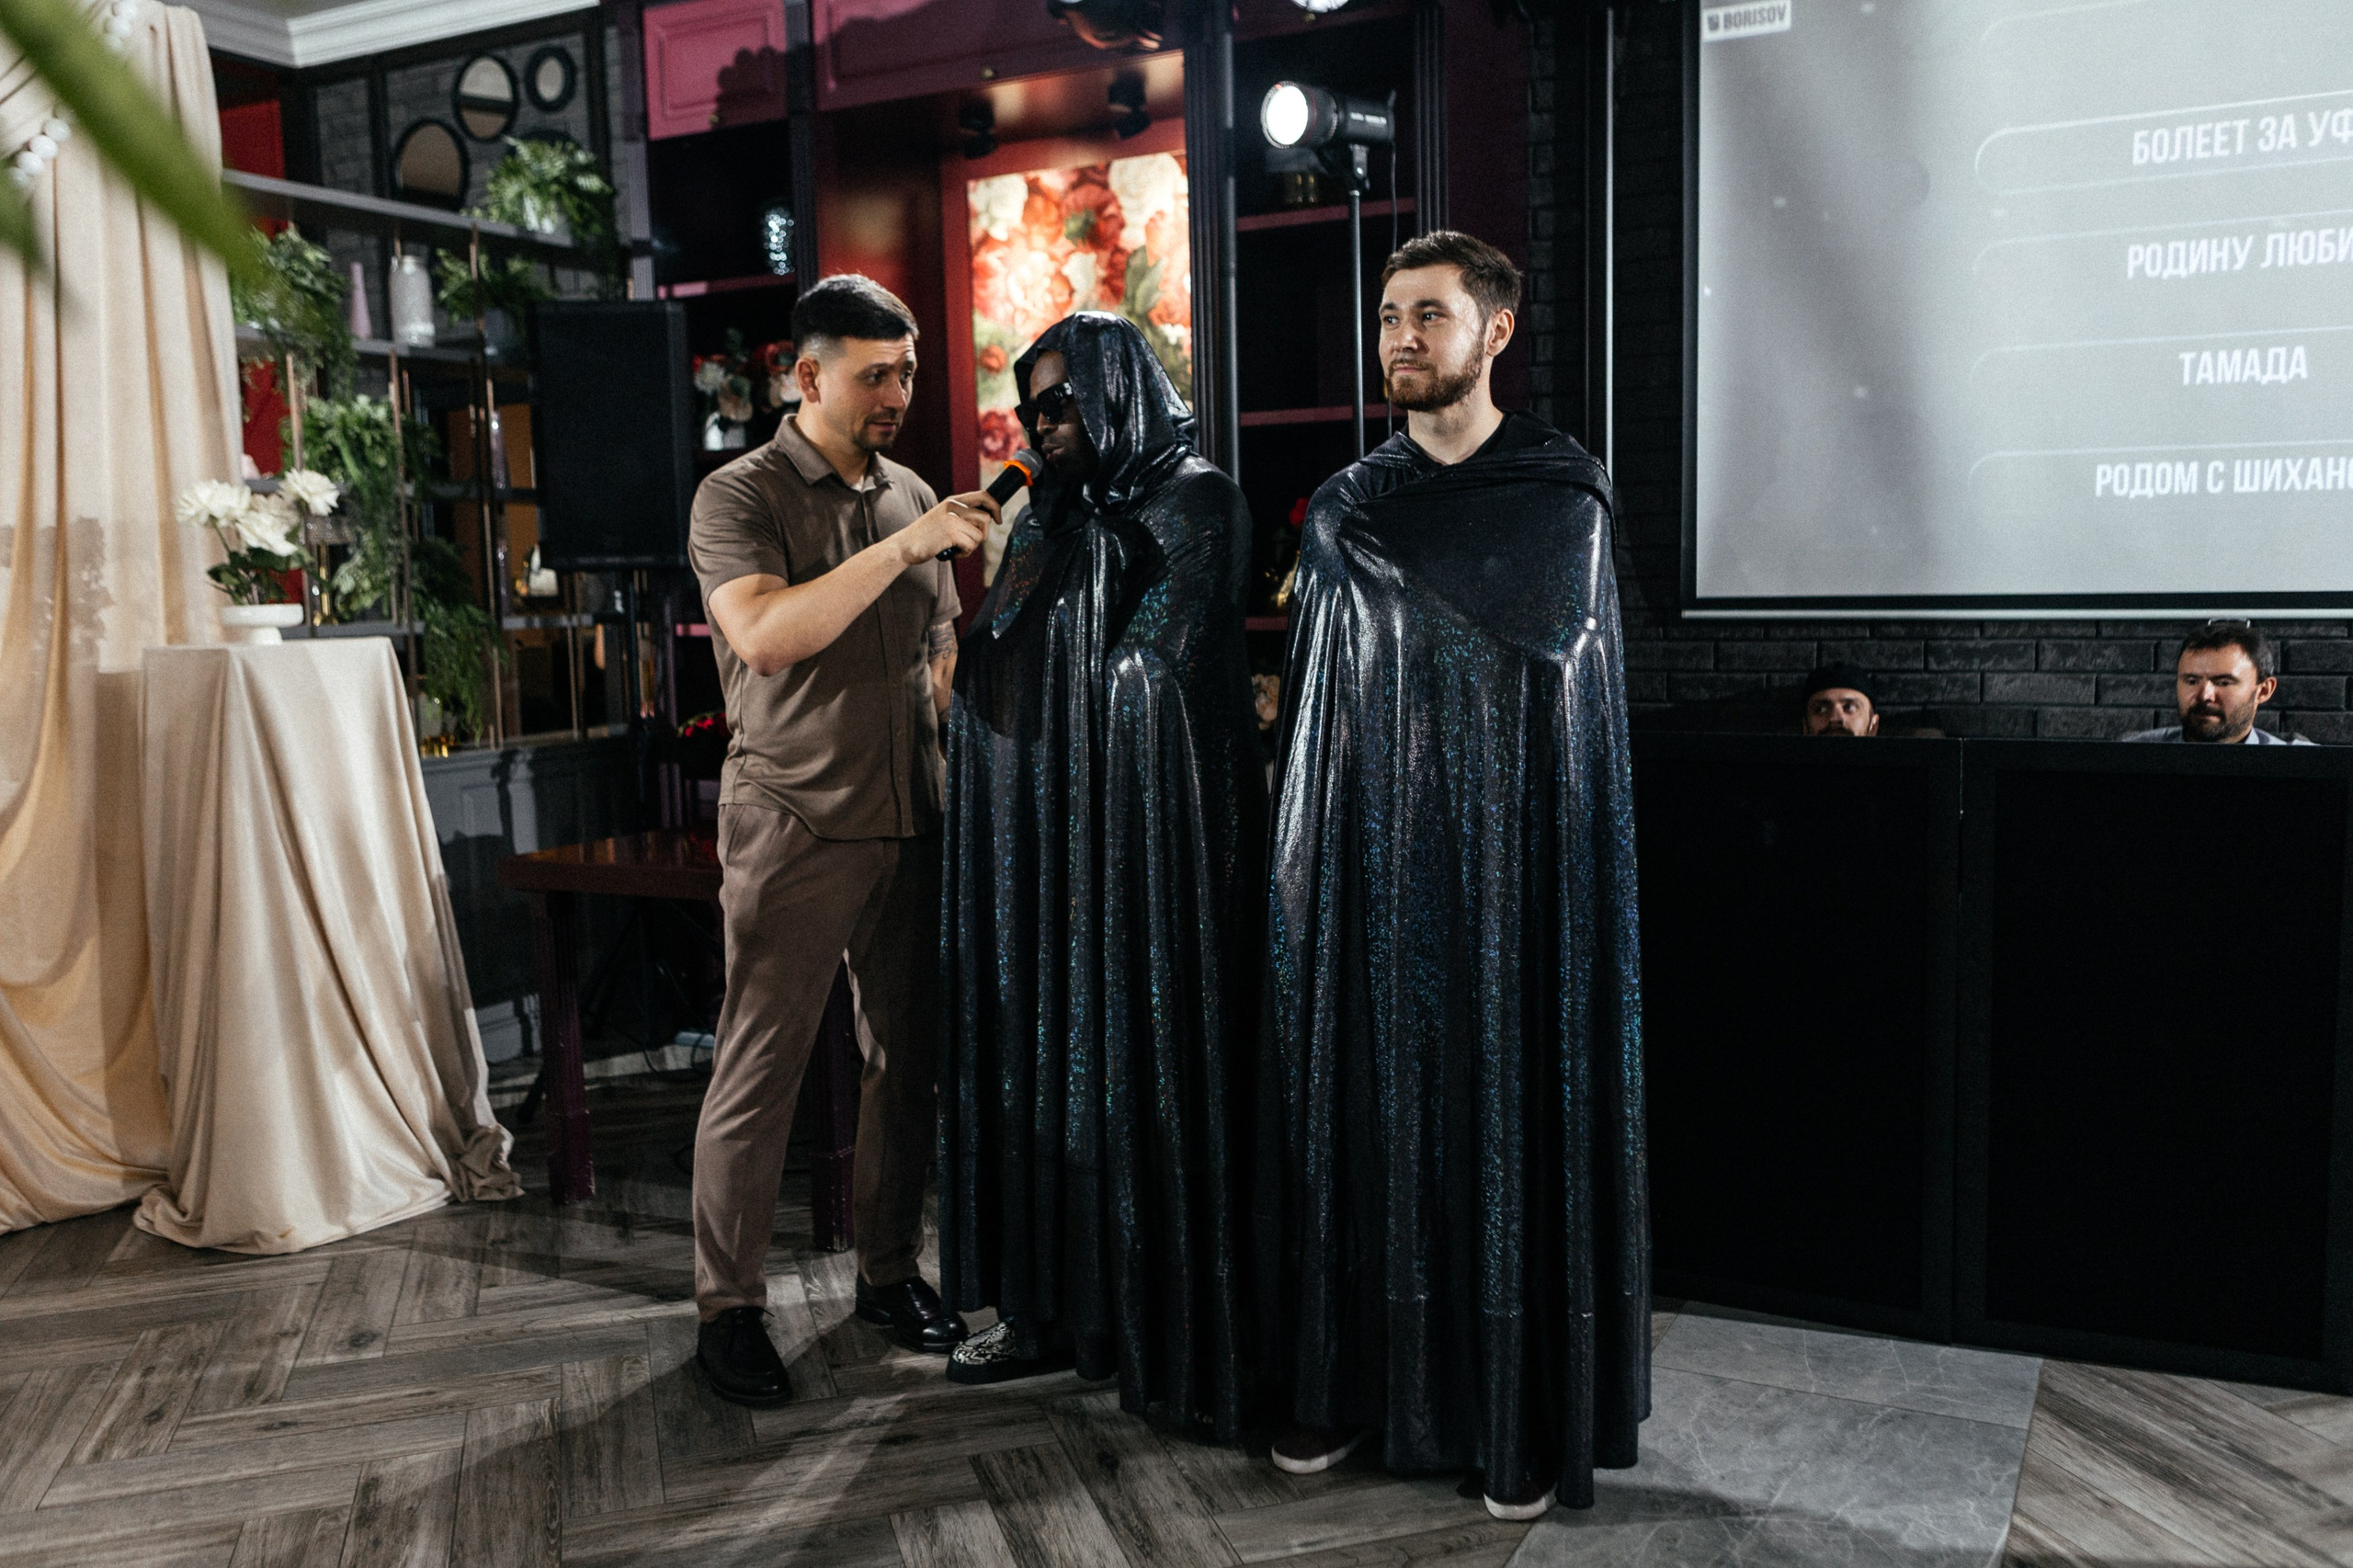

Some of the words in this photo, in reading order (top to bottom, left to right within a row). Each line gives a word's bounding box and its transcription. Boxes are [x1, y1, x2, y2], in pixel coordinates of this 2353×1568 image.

[1723, 4, 1787, 28] BORISOV
[2131, 119, 2250, 165] БОЛЕЕТ
[2257, 113, 2297, 153] ЗА
[2127, 234, 2253, 279] РОДИНУ
[2260, 227, 2353, 268] ЛЮБИ
[2178, 345, 2308, 386] ТАМАДА
[2096, 460, 2199, 499] РОДОМ
[2206, 460, 2225, 494] С
